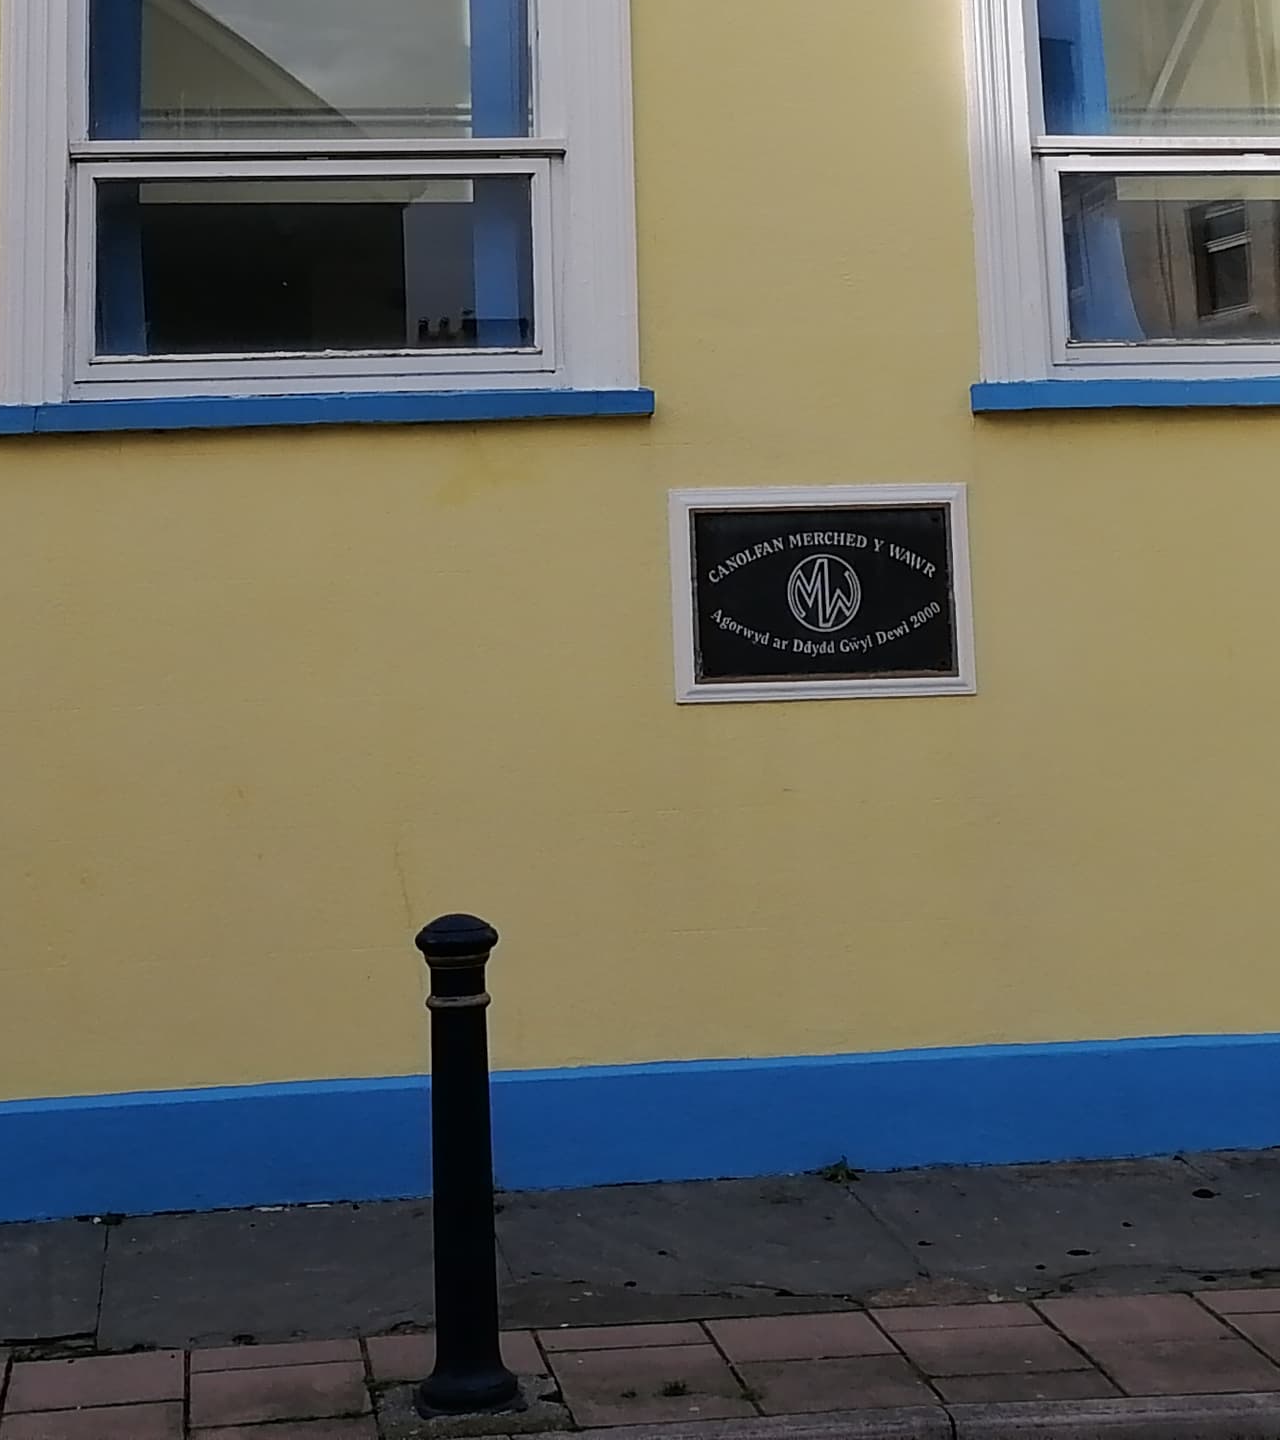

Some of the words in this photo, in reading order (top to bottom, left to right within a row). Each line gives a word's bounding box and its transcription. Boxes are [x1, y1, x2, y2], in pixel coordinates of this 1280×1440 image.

[708, 536, 785, 583] CANOLFAN
[788, 531, 868, 549] MERCHED
[873, 538, 885, 553] Y
[889, 543, 936, 578] WAWR
[710, 608, 771, 646] Agorwyd
[772, 637, 789, 651] ar
[792, 638, 836, 658] Ddydd
[875, 620, 910, 646] Dewi
[910, 601, 941, 629] 2000
